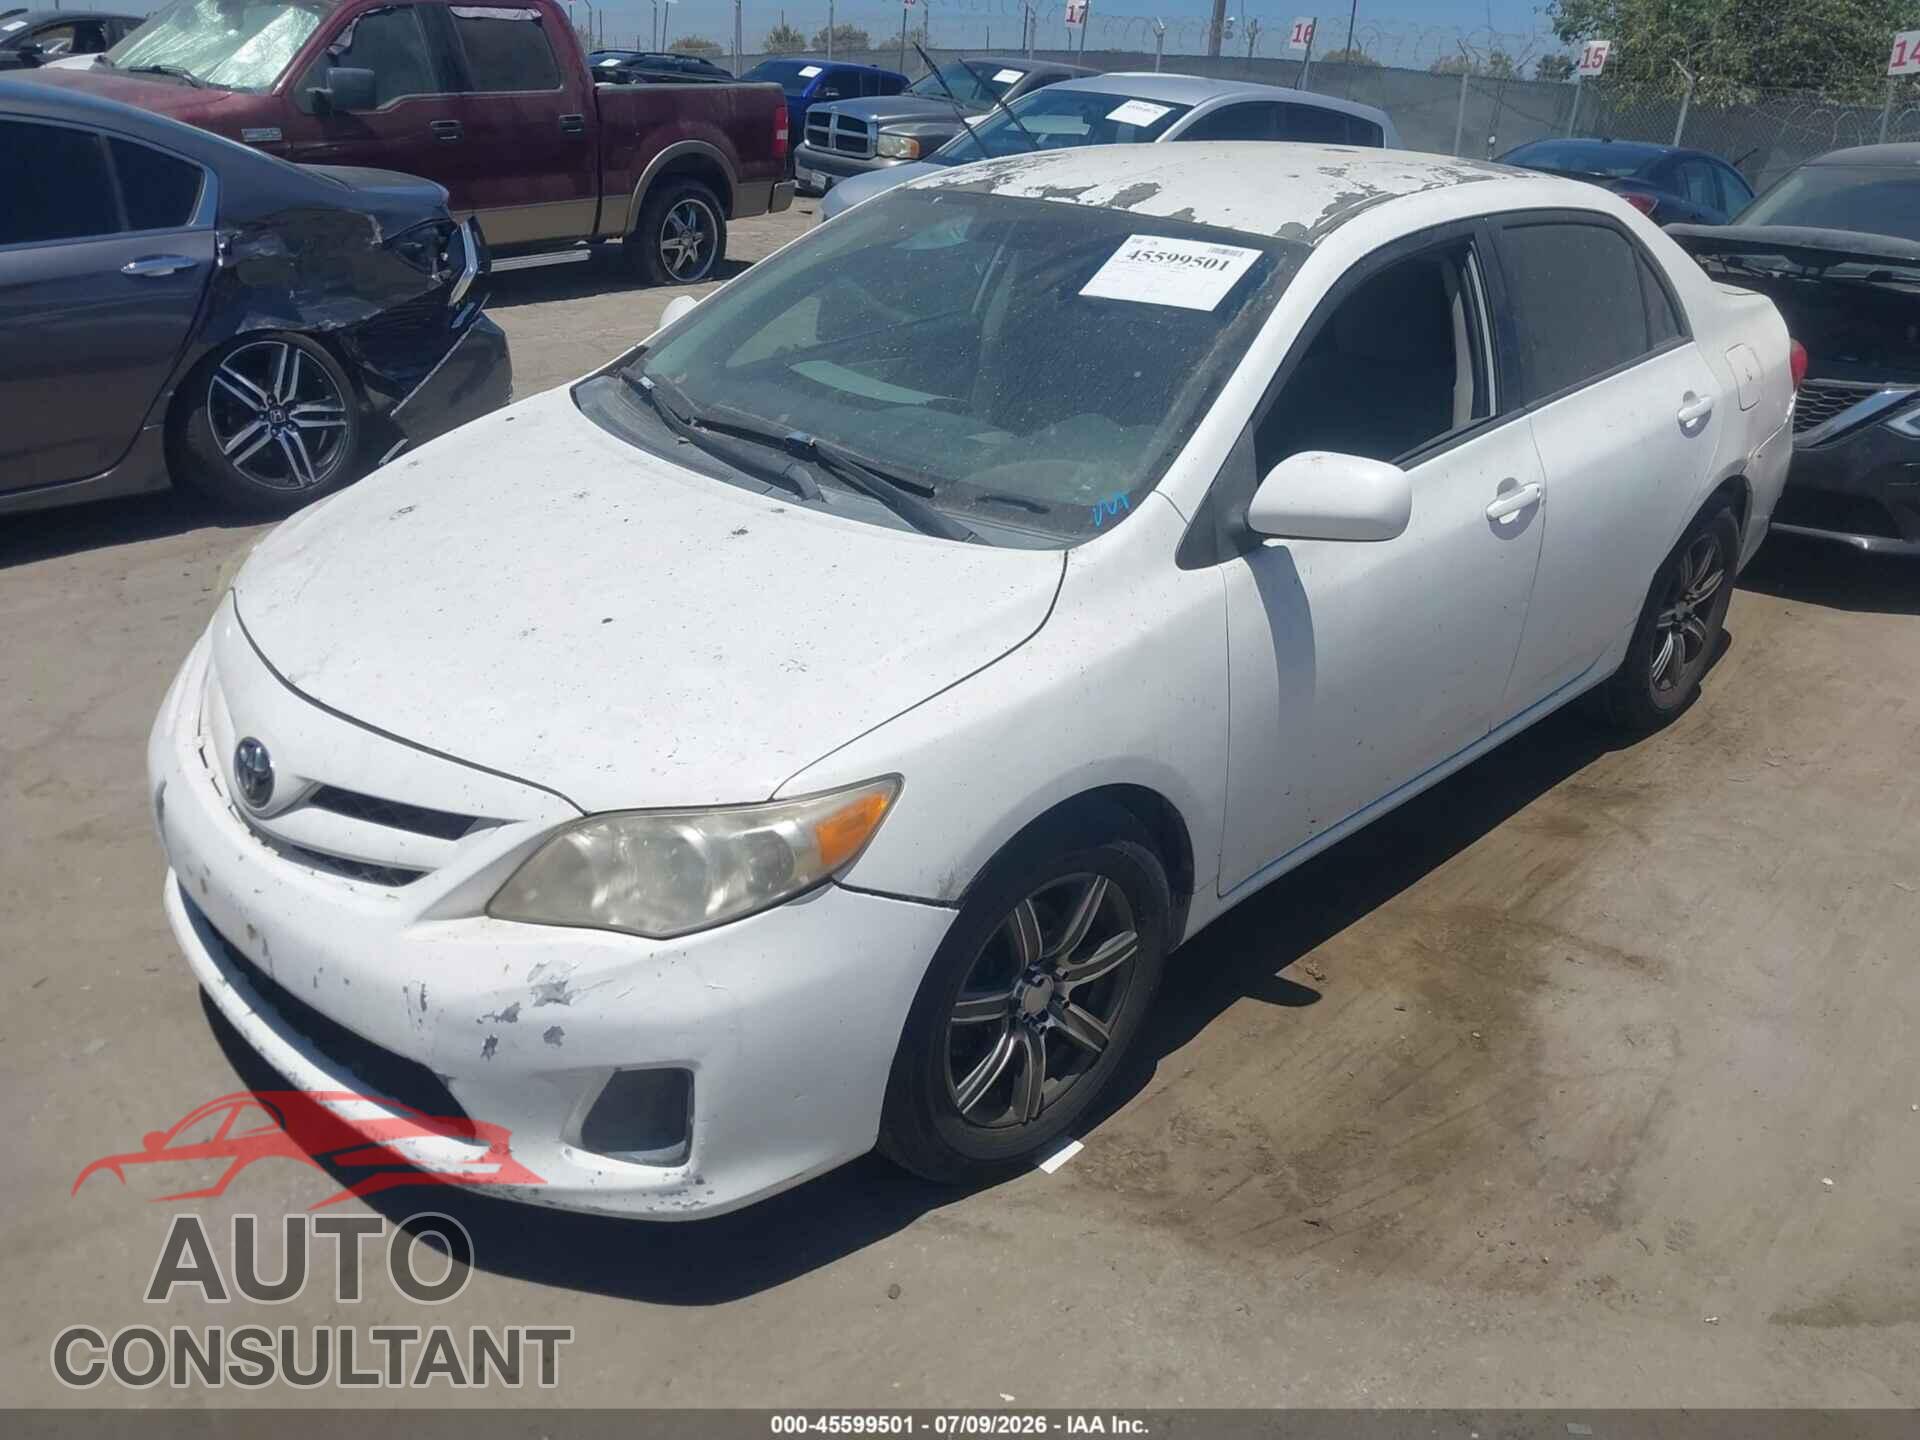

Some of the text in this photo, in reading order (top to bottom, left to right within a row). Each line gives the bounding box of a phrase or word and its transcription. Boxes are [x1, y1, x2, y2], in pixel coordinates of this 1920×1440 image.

[1066, 4, 1087, 24] 17
[1293, 23, 1313, 44] 16
[1581, 47, 1605, 68] 15
[1127, 250, 1230, 271] 45599501
